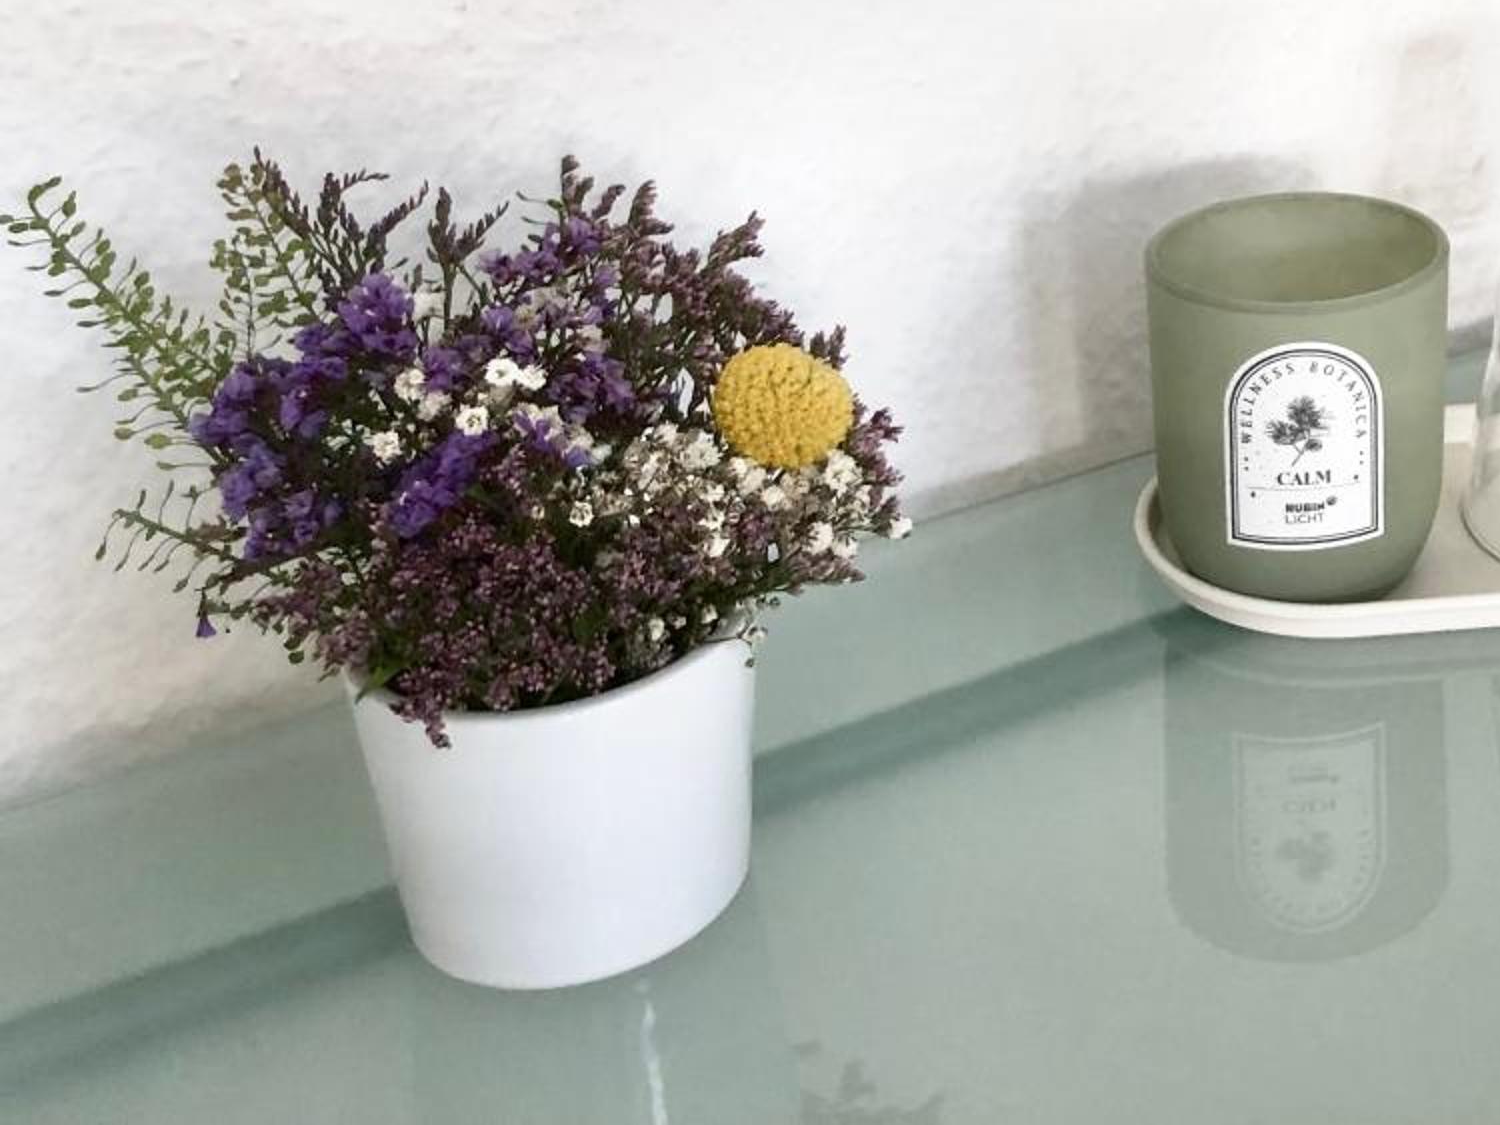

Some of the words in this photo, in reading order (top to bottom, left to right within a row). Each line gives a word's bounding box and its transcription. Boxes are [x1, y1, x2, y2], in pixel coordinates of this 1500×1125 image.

[1240, 362, 1296, 444] WELLNESS
[1309, 361, 1368, 439] BOTANICA
[1276, 469, 1332, 486] CALM
[1284, 512, 1325, 524] LICHT
